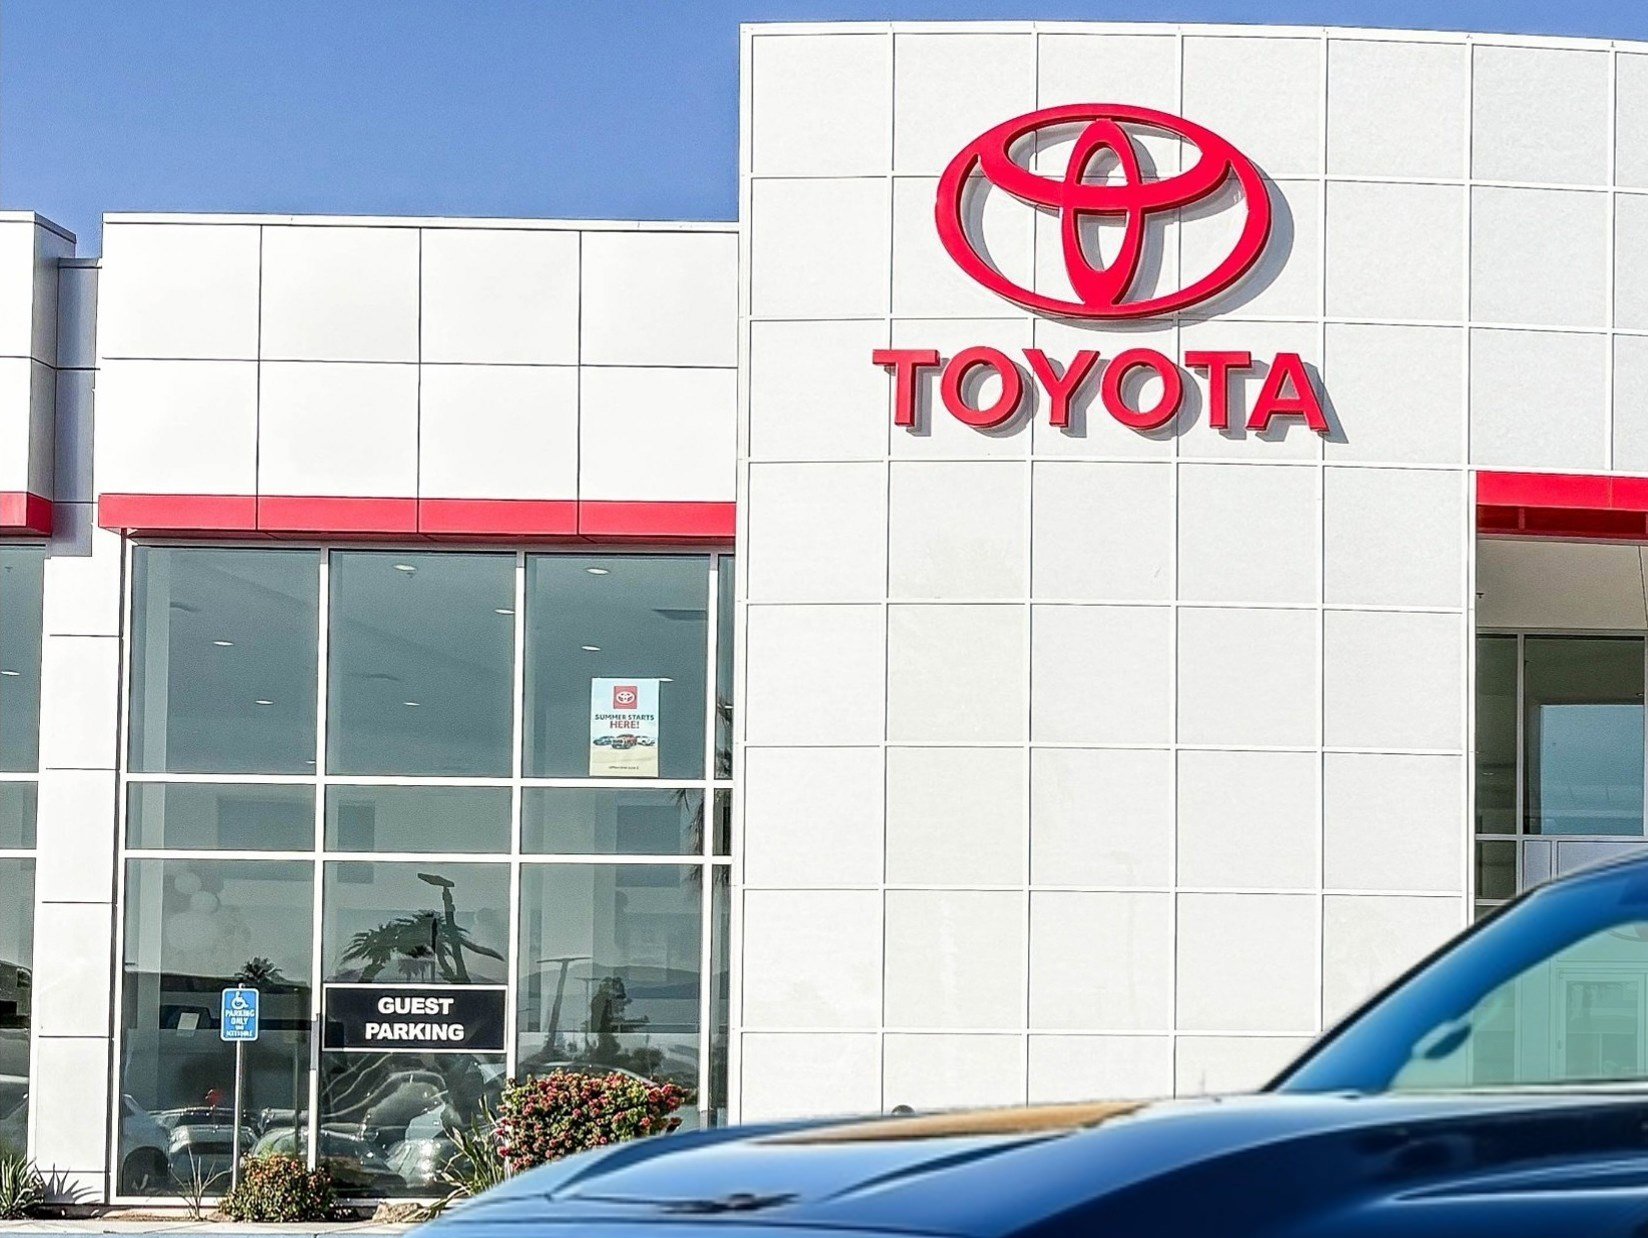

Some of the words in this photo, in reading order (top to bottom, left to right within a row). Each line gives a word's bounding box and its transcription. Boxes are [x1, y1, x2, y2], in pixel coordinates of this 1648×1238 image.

[872, 346, 1331, 434] TOYOTA
[609, 720, 640, 729] HERE!
[377, 997, 455, 1015] GUEST
[225, 1009, 256, 1018] PARKING
[230, 1017, 250, 1025] ONLY
[365, 1022, 465, 1041] PARKING
